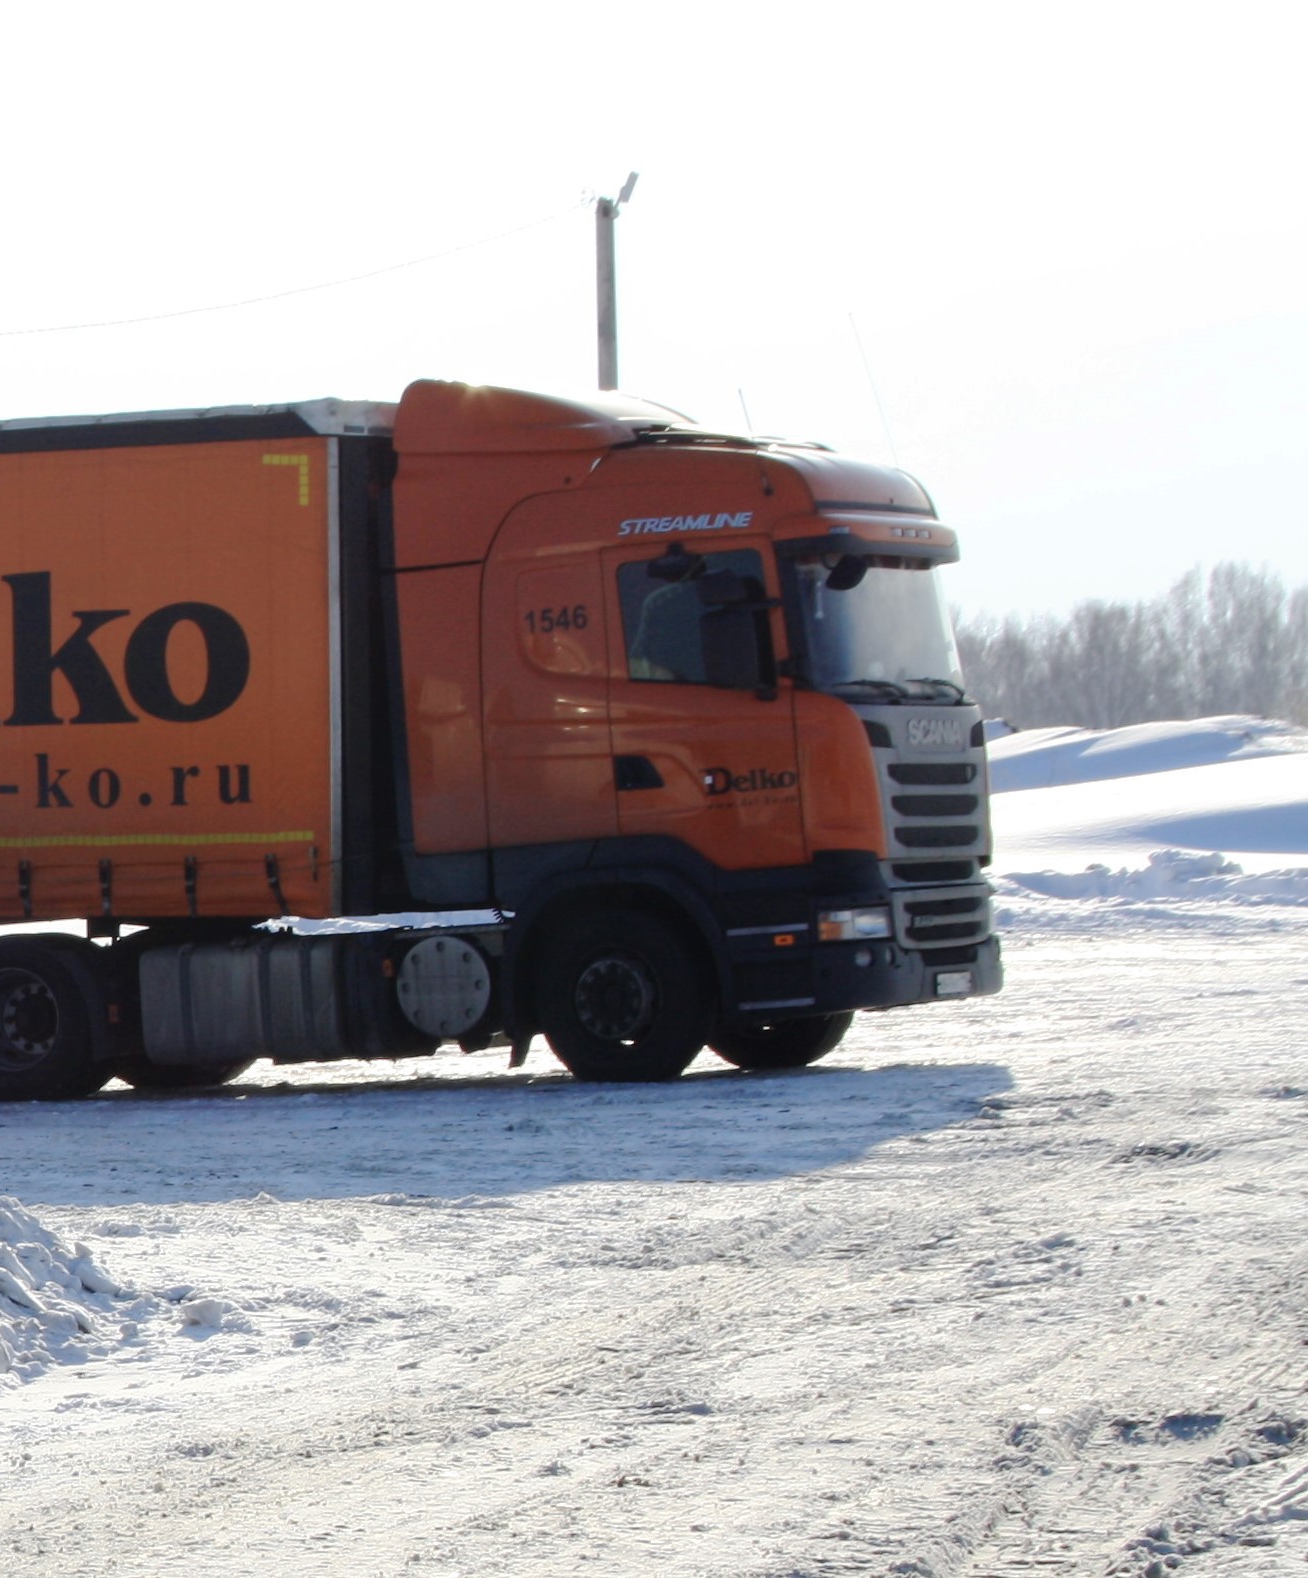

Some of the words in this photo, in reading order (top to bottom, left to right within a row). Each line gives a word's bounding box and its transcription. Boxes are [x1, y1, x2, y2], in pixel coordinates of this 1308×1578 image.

[617, 511, 754, 536] STREAMLINE
[524, 604, 589, 635] 1546
[907, 719, 966, 745] SCANIA
[697, 767, 798, 796] Delko
